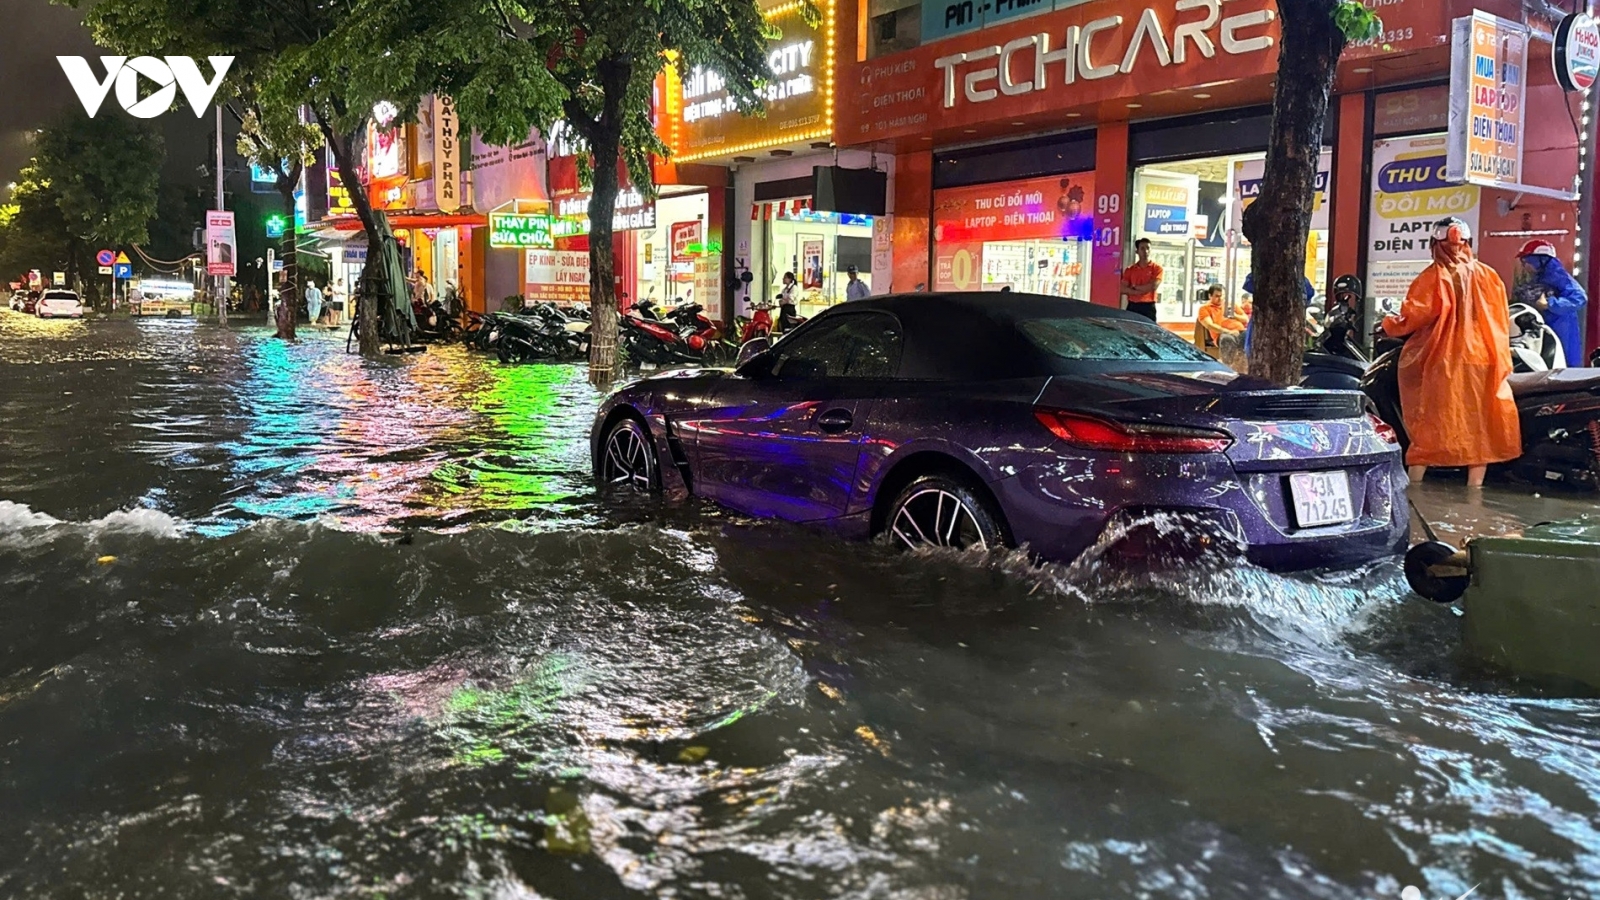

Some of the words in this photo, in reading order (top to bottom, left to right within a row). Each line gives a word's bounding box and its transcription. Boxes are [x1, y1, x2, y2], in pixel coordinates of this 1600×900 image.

[769, 40, 814, 75] CITY
[934, 0, 1275, 108] TECHCARE
[1476, 55, 1494, 79] MUA
[1475, 85, 1517, 113] LAPTOP
[1473, 114, 1492, 142] ĐIỆN
[442, 162, 453, 199] PHAN
[1386, 167, 1431, 184] THU
[975, 198, 992, 209] THU
[1025, 190, 1042, 206] MỚI
[1097, 193, 1120, 214] 99
[1427, 192, 1471, 210] MỚI
[493, 217, 525, 229] THAY
[528, 218, 549, 230] PIN
[965, 215, 997, 228] LAPTOP
[1004, 211, 1025, 227] ĐIỆN
[1027, 210, 1054, 225] THOẠI
[1147, 209, 1172, 219] LAPTOP
[1374, 236, 1413, 254] ĐIỆN
[120, 267, 128, 275] P
[1311, 475, 1335, 497] 43A
[1301, 498, 1348, 522] 712.45
